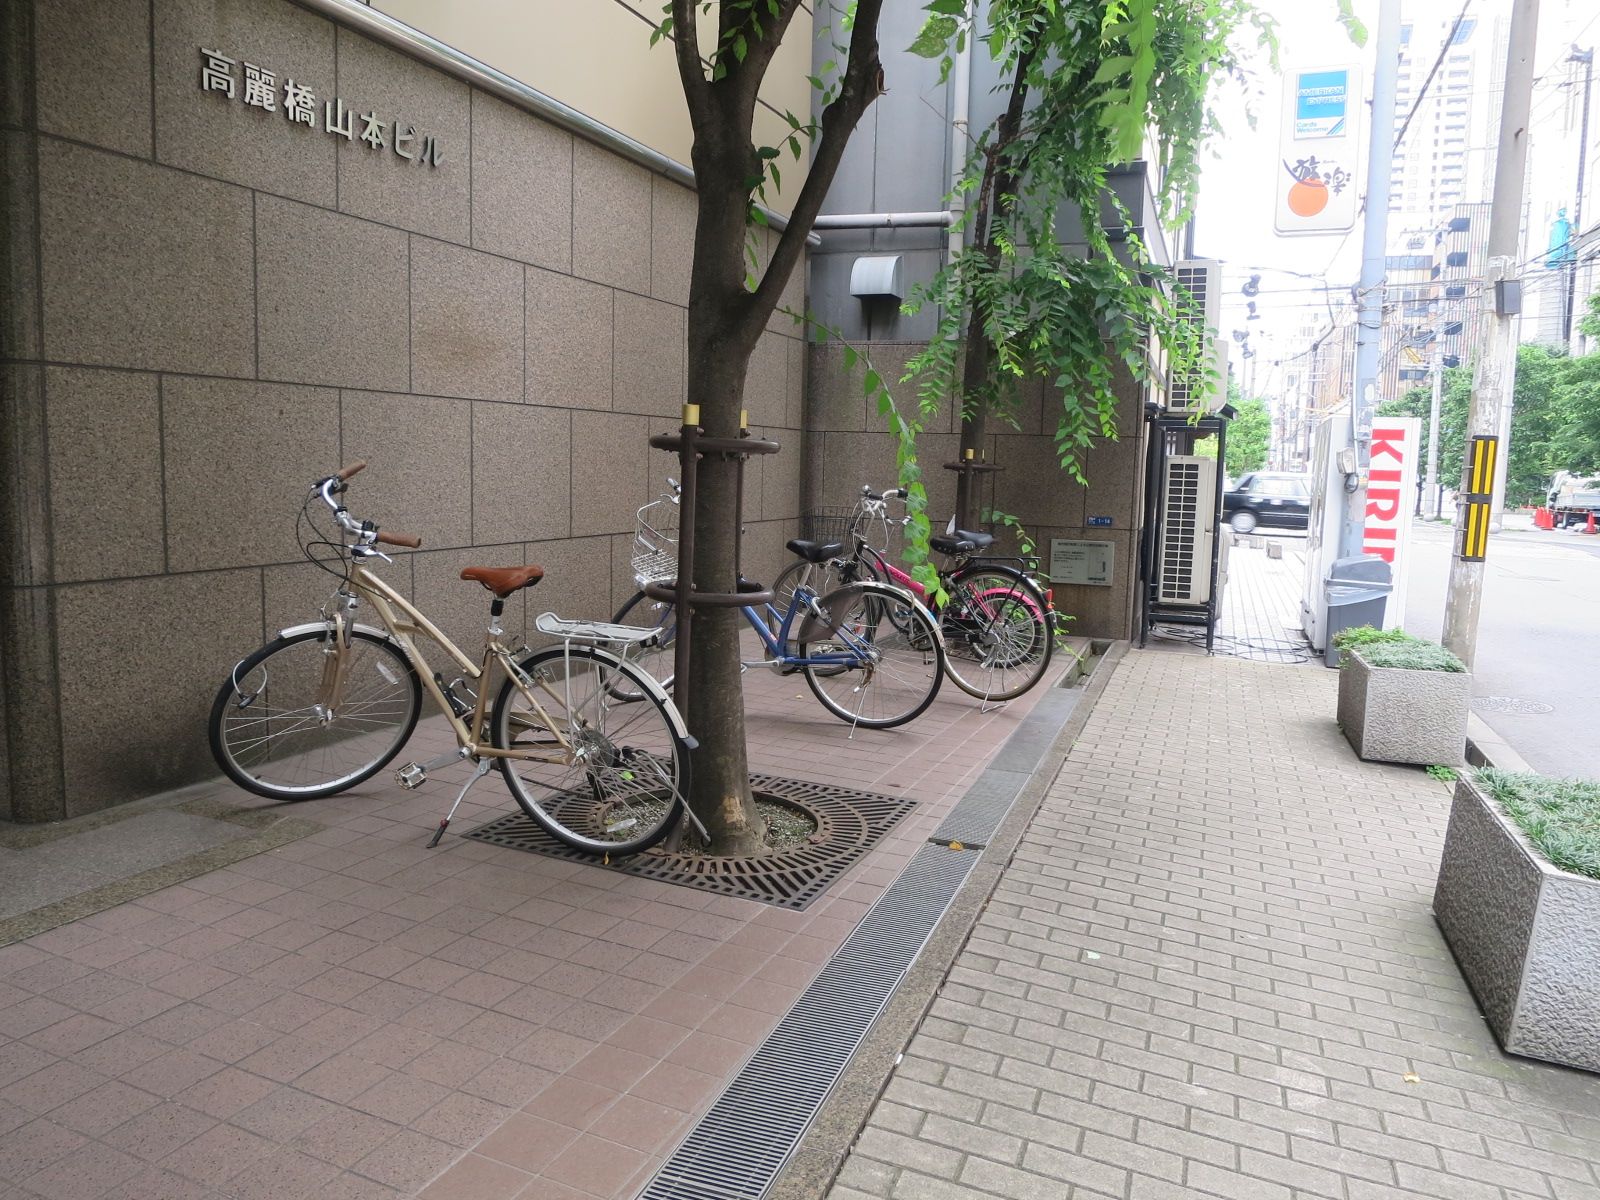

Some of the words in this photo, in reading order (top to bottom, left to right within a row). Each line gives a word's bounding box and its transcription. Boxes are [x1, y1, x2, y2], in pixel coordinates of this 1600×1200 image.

[200, 47, 443, 168] 高麗橋山本ビル
[1298, 86, 1345, 96] AMERICAN
